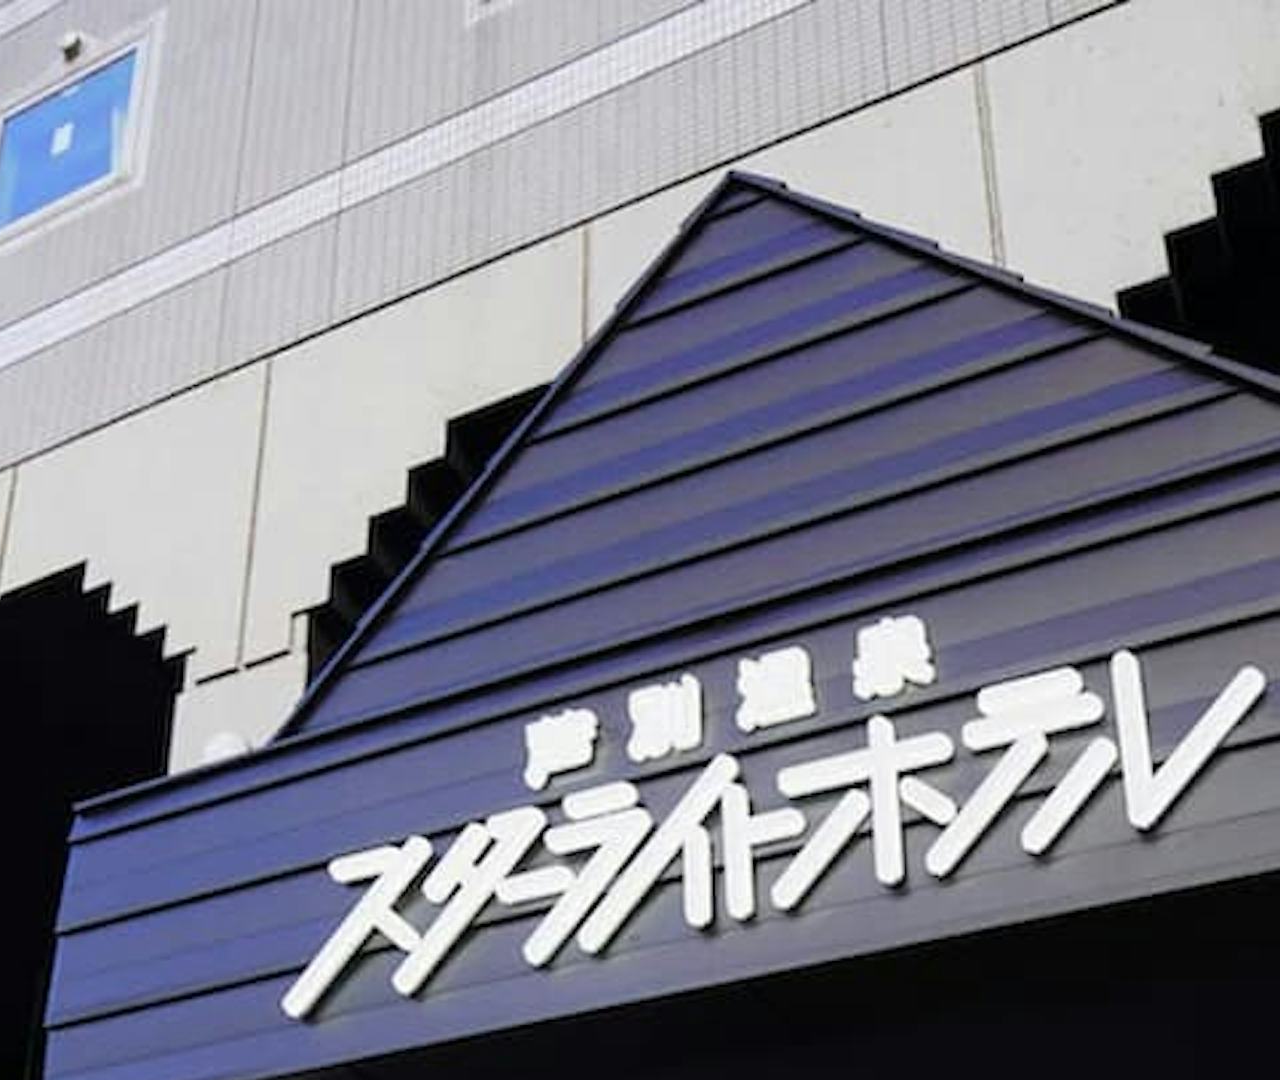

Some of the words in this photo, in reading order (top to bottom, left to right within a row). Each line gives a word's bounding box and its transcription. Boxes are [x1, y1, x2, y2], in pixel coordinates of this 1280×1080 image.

[281, 650, 1266, 1019] スターライトホテル
